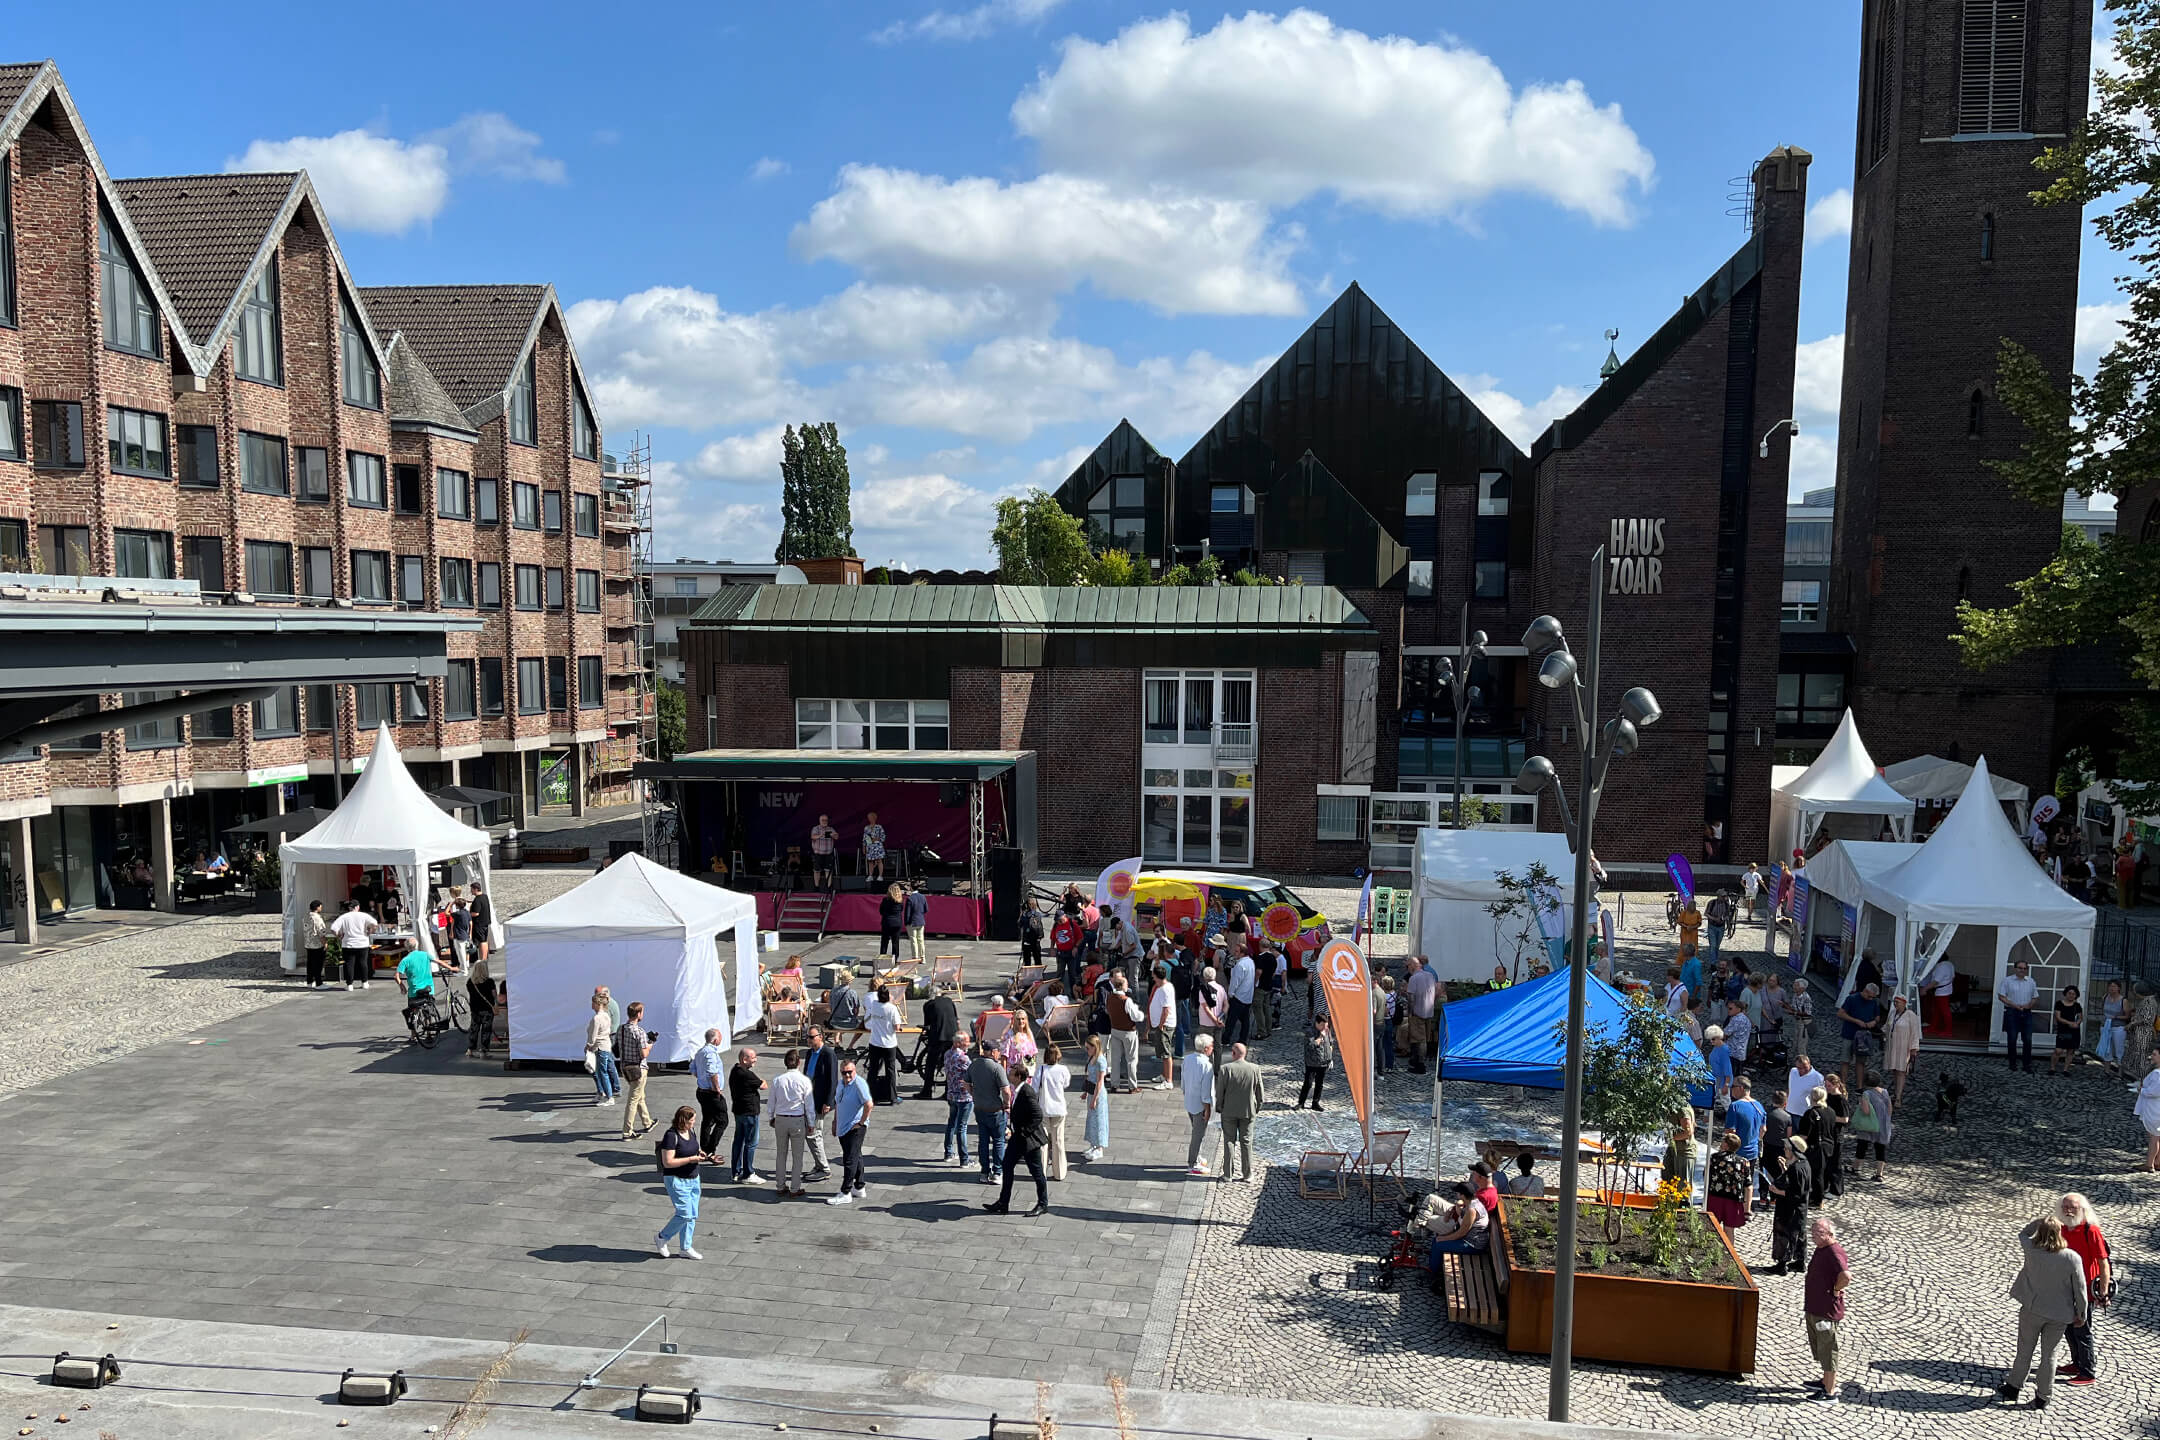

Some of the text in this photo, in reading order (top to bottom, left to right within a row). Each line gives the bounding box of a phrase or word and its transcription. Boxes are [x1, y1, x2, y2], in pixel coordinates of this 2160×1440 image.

[1610, 518, 1666, 556] HAUS
[1608, 557, 1662, 595] ZOAR
[2033, 805, 2054, 825] BIS
